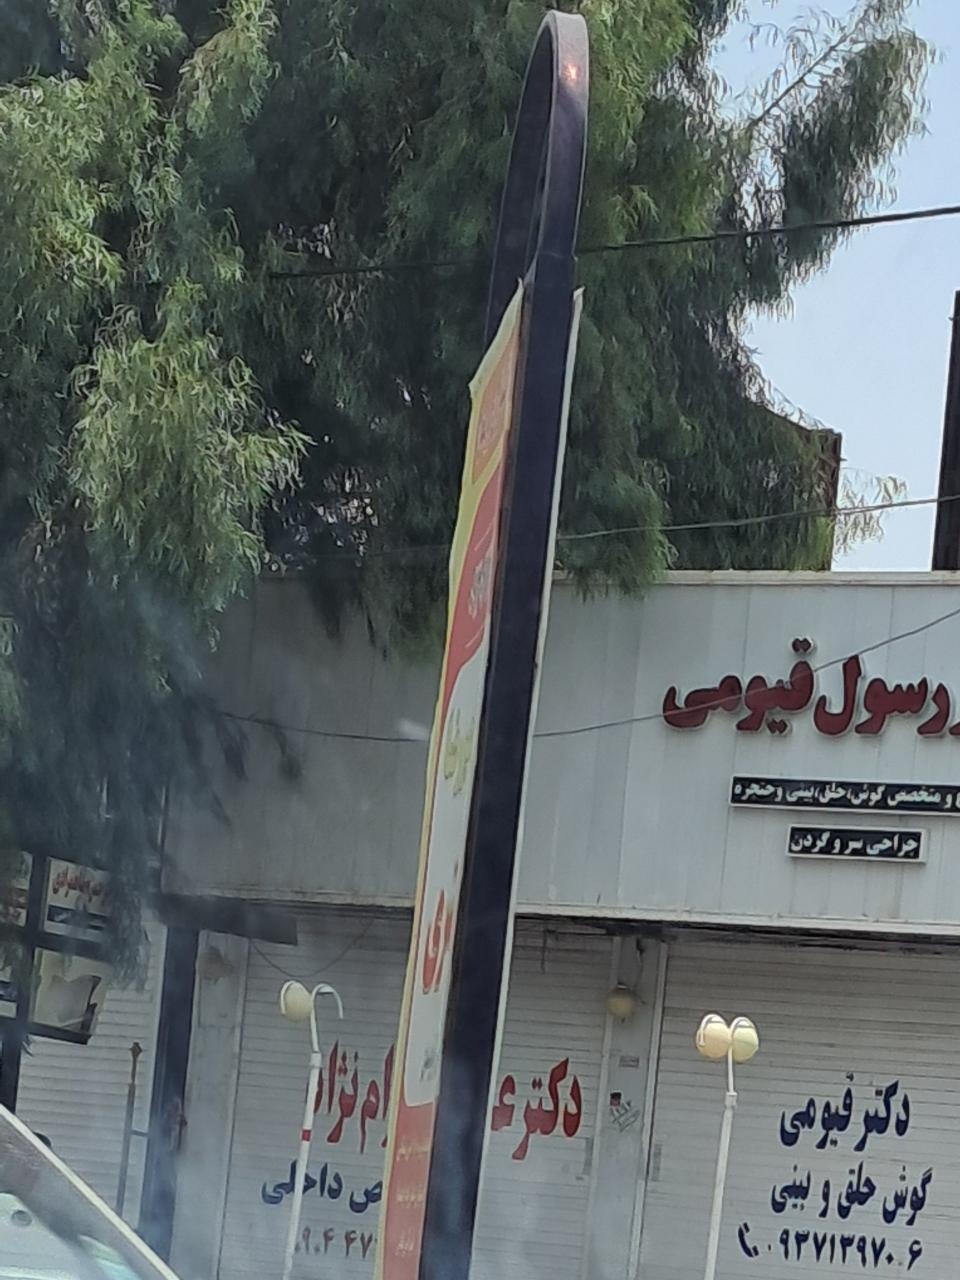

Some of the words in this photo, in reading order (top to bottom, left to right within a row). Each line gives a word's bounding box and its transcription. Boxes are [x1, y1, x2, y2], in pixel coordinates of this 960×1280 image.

[661, 637, 815, 735] قیومی
[814, 654, 951, 737] رسول
[887, 785, 941, 806] متخصص
[944, 792, 952, 809] و
[790, 830, 831, 853] گردن
[832, 837, 841, 854] و
[843, 838, 864, 855] سر
[866, 833, 918, 857] جراحی
[511, 1056, 582, 1161] دکتر
[779, 1071, 853, 1149] قیومی
[853, 1080, 910, 1151] دکتر
[771, 1165, 811, 1213] بینی
[818, 1179, 830, 1218] و
[837, 1160, 877, 1220] حلق
[882, 1166, 933, 1225] گوش
